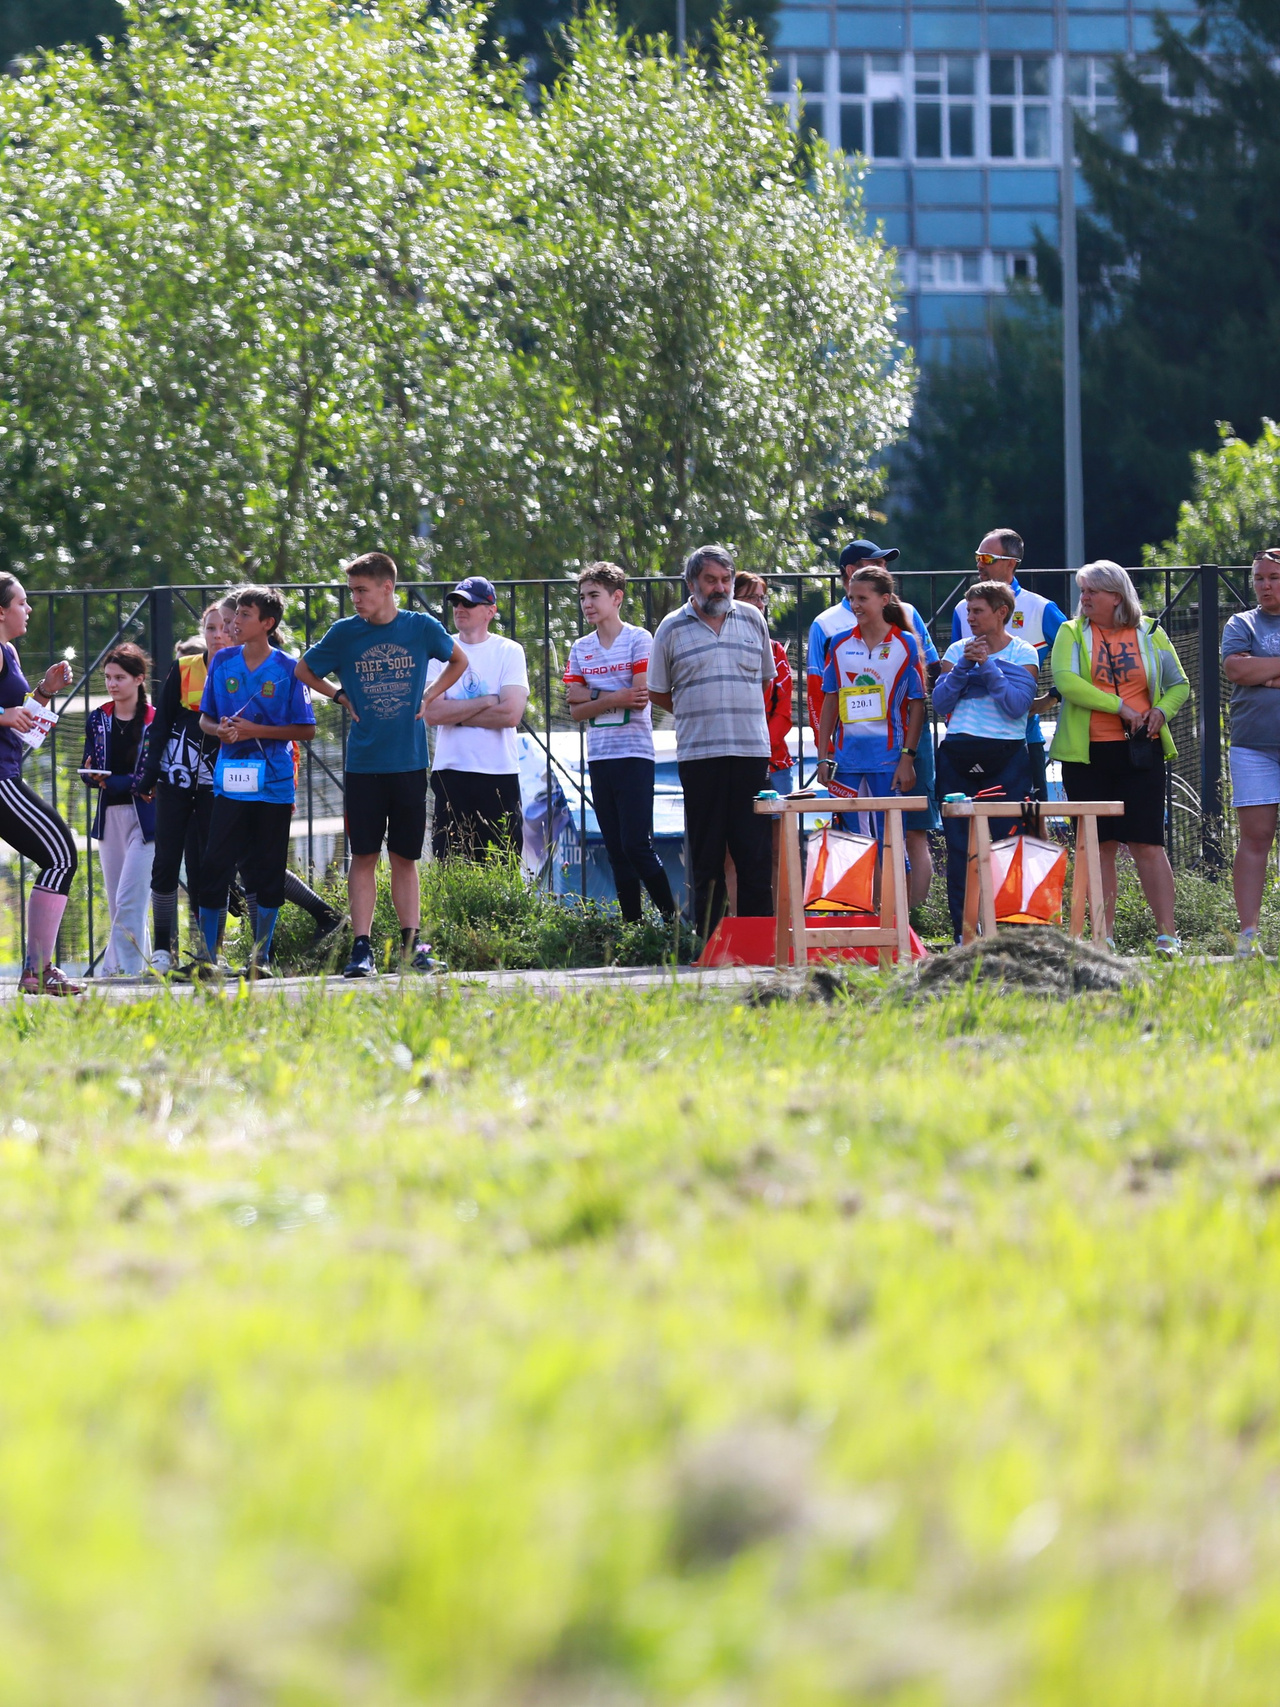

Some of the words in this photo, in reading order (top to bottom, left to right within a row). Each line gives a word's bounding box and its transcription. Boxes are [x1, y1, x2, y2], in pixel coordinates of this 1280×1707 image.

[355, 660, 383, 673] FREE
[388, 656, 415, 670] SOUL
[581, 666, 608, 675] NORD
[610, 662, 632, 672] WES
[366, 673, 375, 681] 18
[395, 670, 405, 679] 65
[851, 699, 872, 709] 220.1
[228, 774, 250, 782] 311.3
